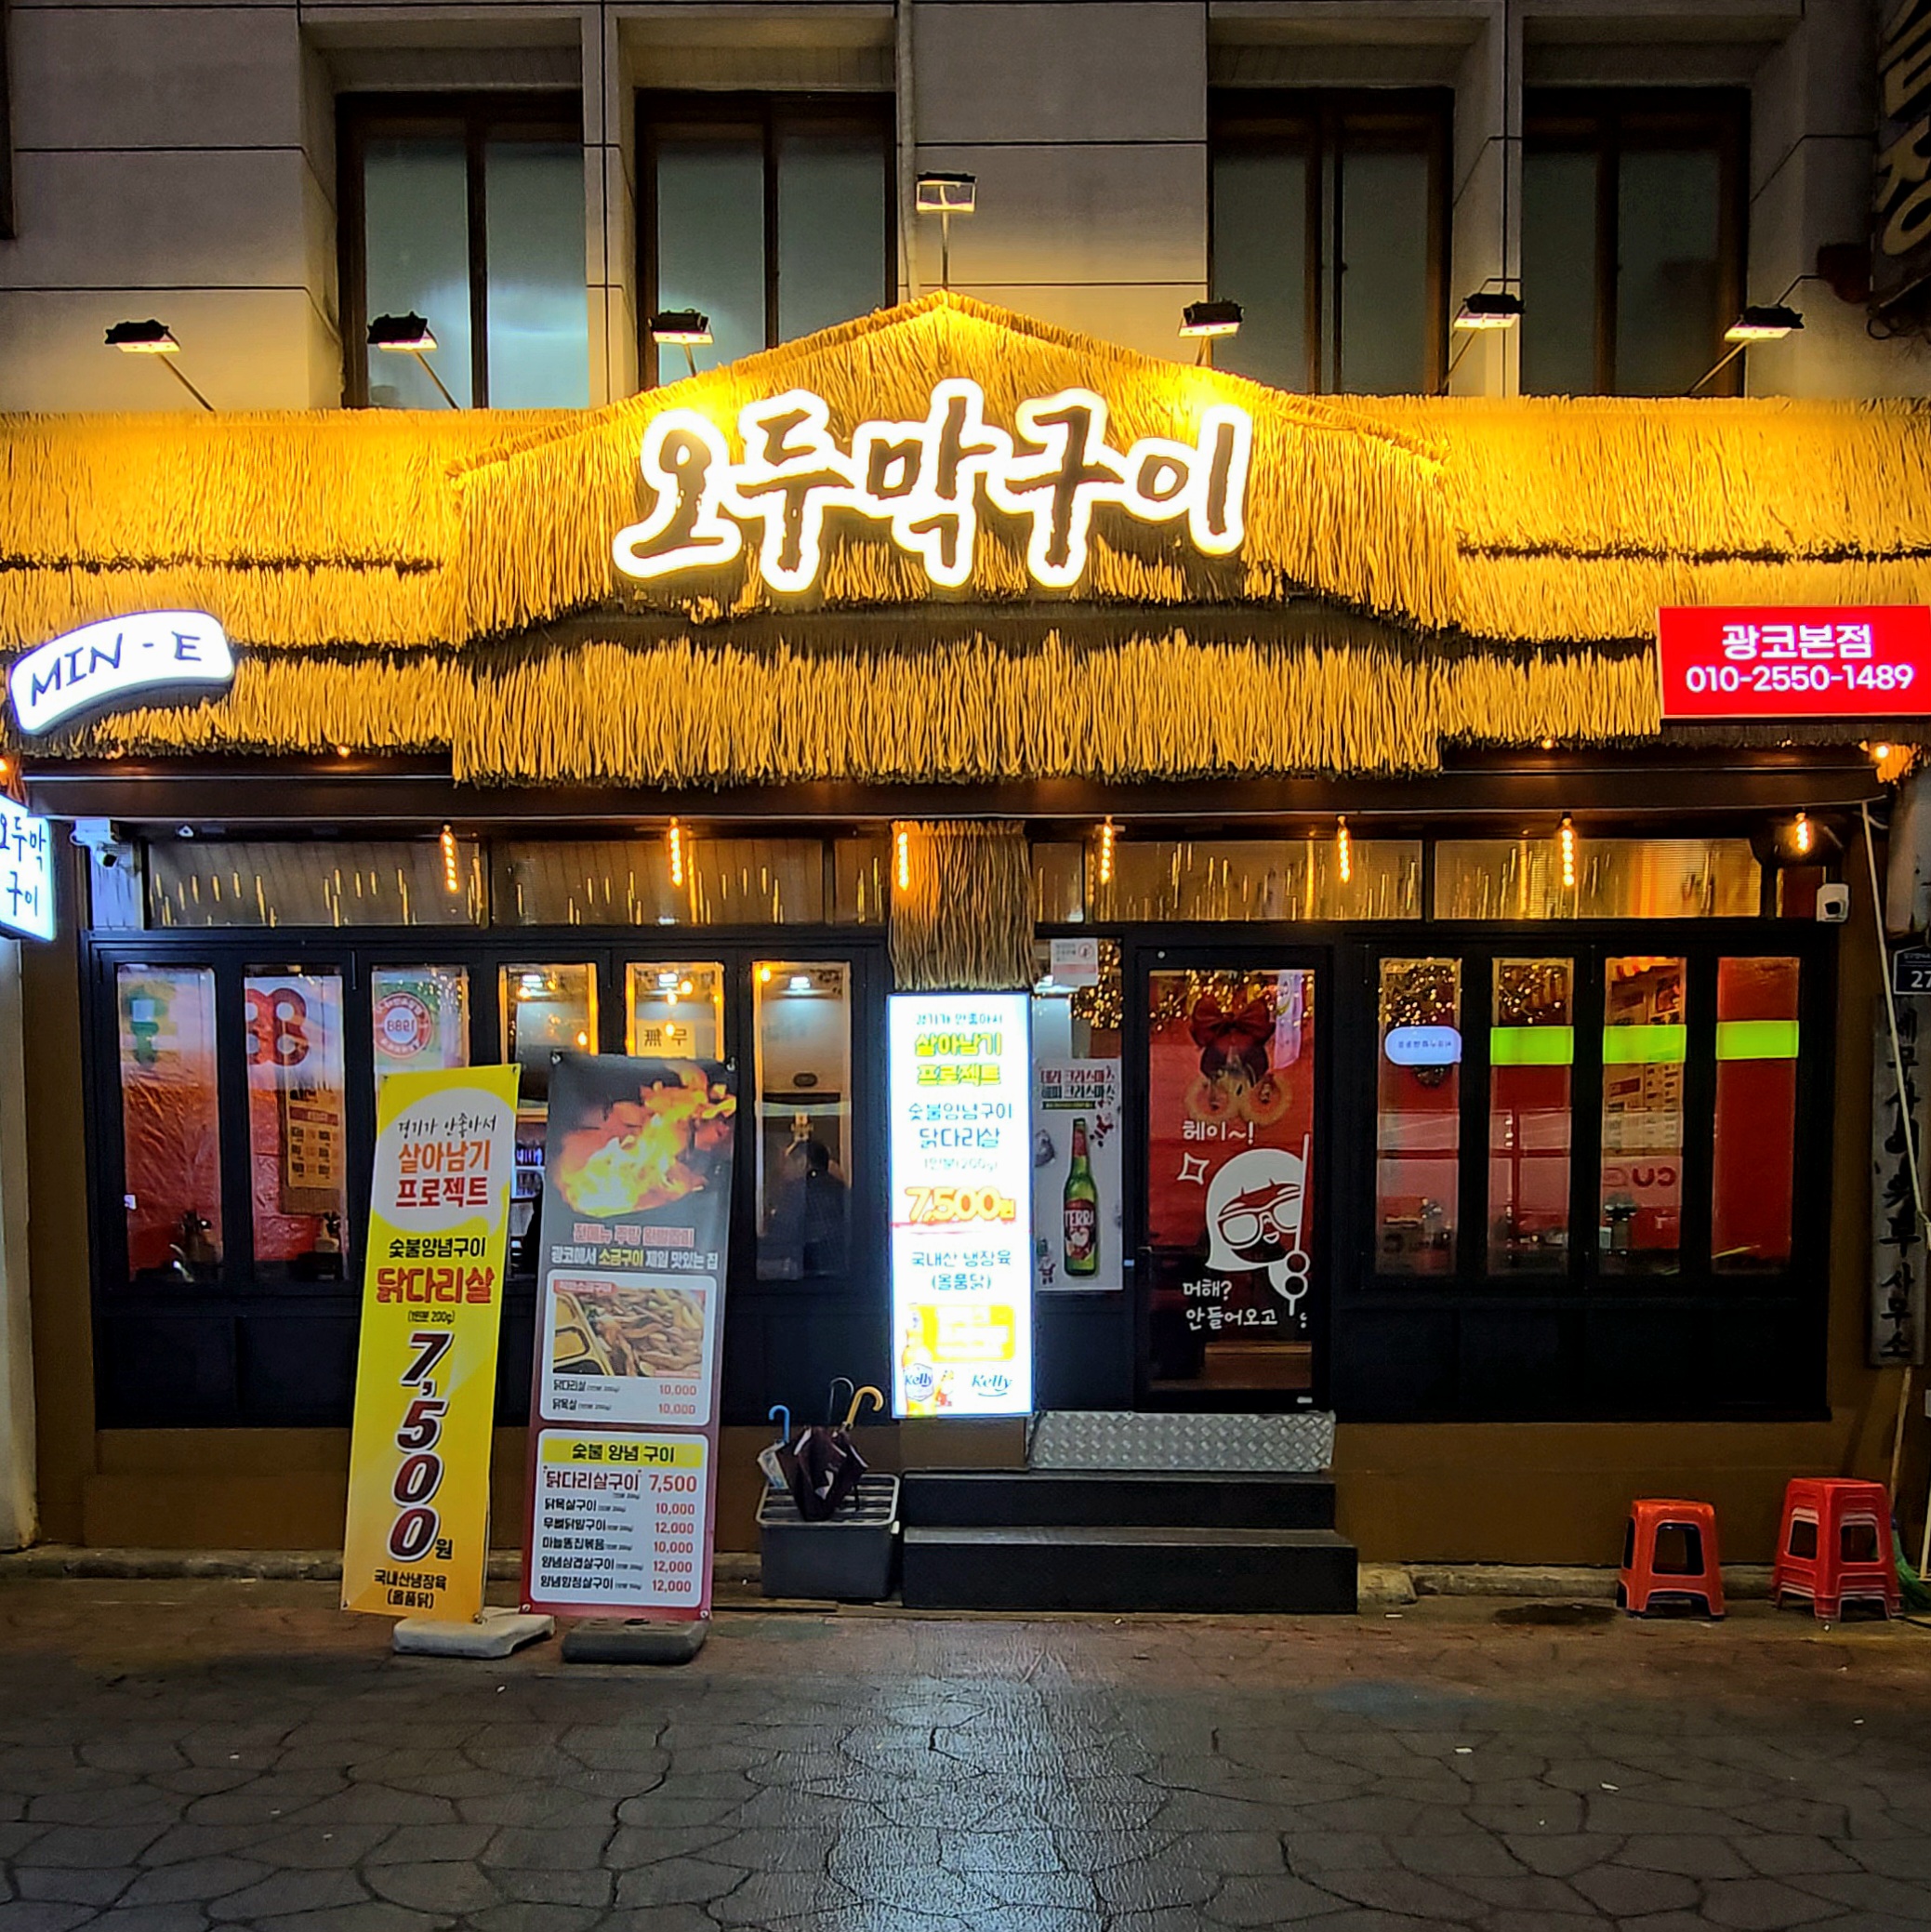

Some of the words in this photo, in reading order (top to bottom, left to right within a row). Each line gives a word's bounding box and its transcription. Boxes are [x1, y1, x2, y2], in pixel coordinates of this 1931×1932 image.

[615, 380, 1251, 591] 오두막구이
[1722, 624, 1872, 660] 광코본점
[1686, 664, 1914, 693] 010-2550-1489
[7, 871, 38, 917] 구이
[915, 1032, 1002, 1056] 살아남기
[917, 1064, 1001, 1087] 프로젝트
[398, 1118, 438, 1139] 경기가
[919, 1128, 999, 1148] 닭다리살
[1183, 1120, 1254, 1145] 헤이~!
[398, 1139, 491, 1173] 살아남기
[396, 1177, 488, 1208] 프로젝트
[389, 1237, 485, 1258] 숯불양념구이
[599, 1248, 643, 1266] 소금구이
[671, 1251, 704, 1269] 맛있는
[707, 1252, 718, 1270] 집
[911, 1251, 956, 1267] 국내산
[963, 1250, 1011, 1267] 냉장육
[377, 1266, 495, 1303] 닭다리살
[1183, 1278, 1232, 1301] 머해?
[1186, 1306, 1277, 1330] 안들어오고
[659, 1384, 696, 1396] 10,000
[905, 1373, 933, 1388] Kelly
[972, 1374, 1012, 1392] Kelly
[658, 1403, 695, 1415] 10,000
[572, 1443, 603, 1461] 숯불
[608, 1445, 639, 1462] 양념
[643, 1446, 675, 1462] 구이
[649, 1475, 697, 1493] 7,500
[655, 1502, 695, 1515] 10,000
[655, 1522, 694, 1535] 12,000
[654, 1542, 694, 1555] 10,000
[653, 1560, 693, 1574] 12,000
[652, 1580, 692, 1594] 12,000
